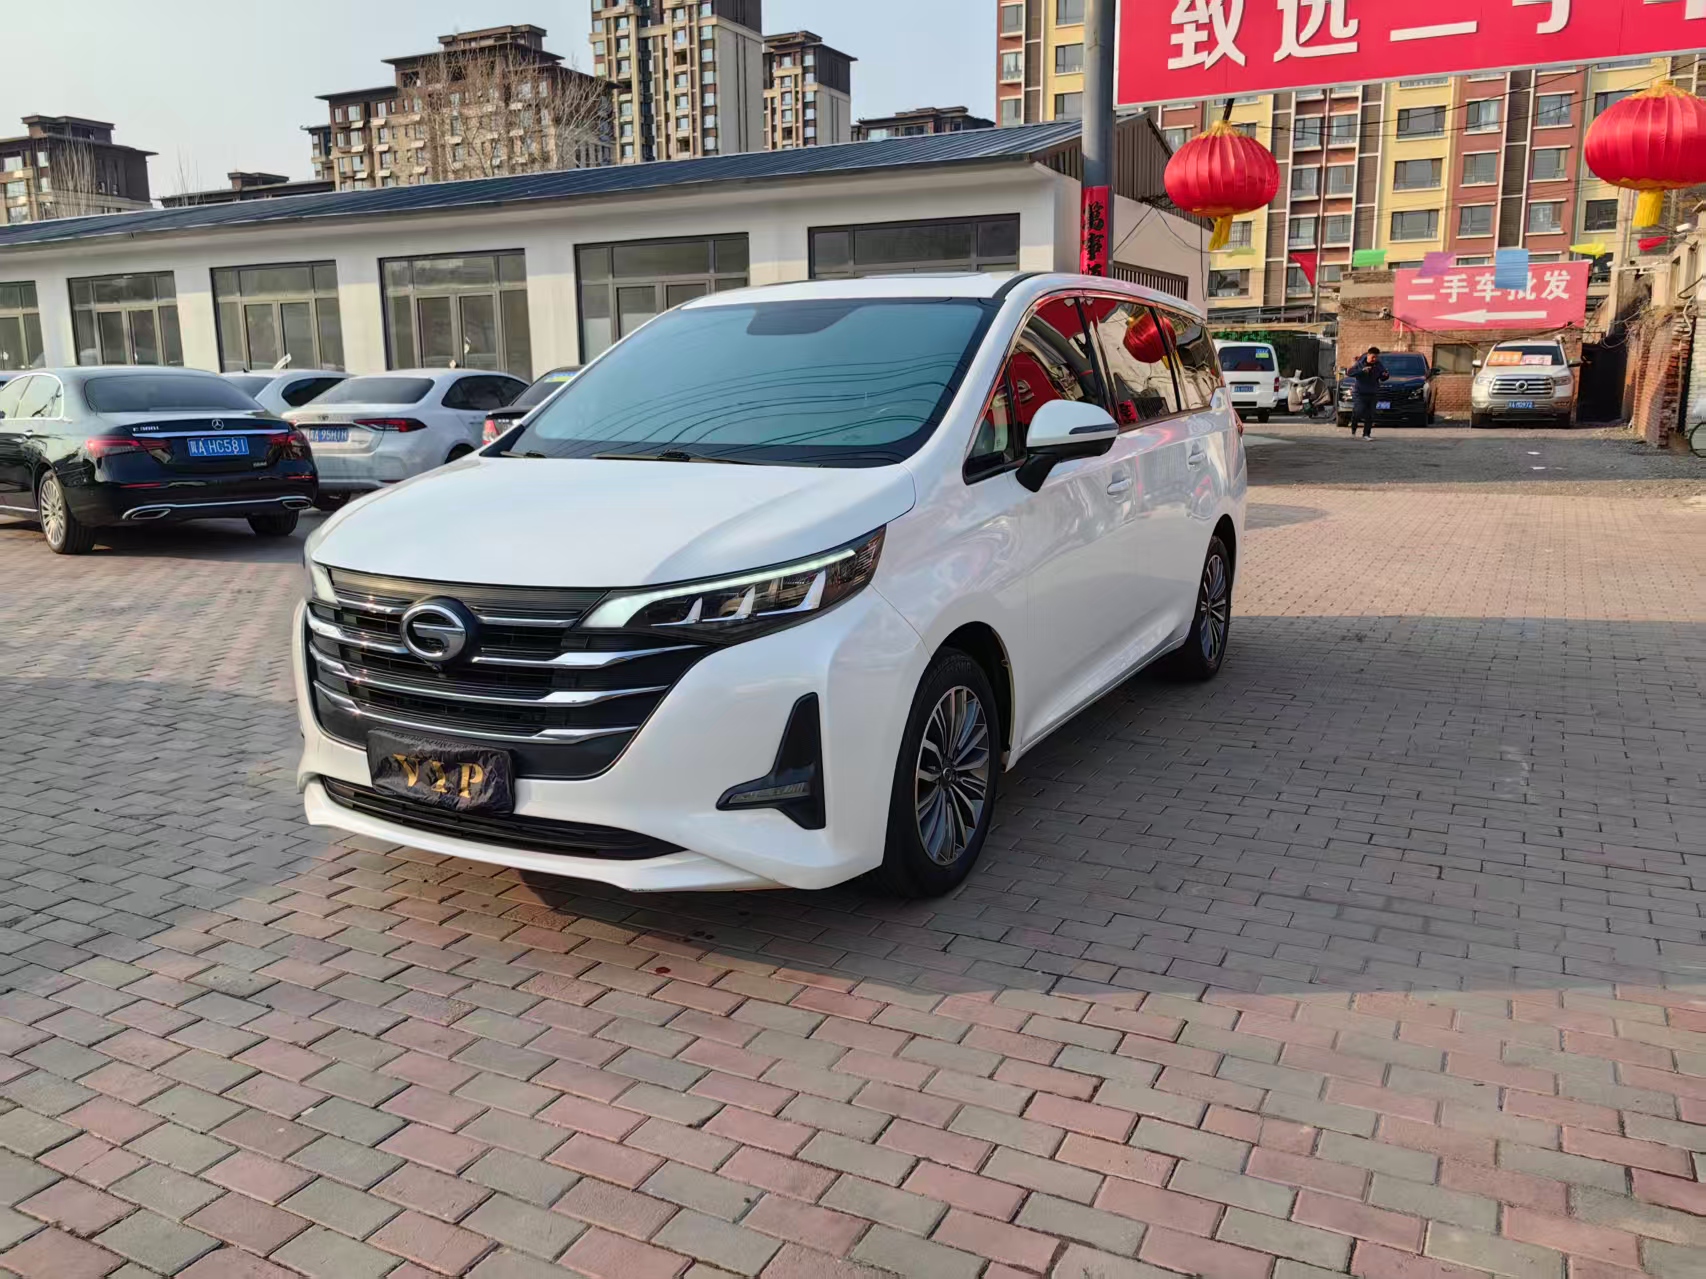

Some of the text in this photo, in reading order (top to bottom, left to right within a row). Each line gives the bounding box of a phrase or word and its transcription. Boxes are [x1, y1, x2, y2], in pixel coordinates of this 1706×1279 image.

[1407, 270, 1571, 303] 二手车批发
[392, 753, 484, 799] VIP
